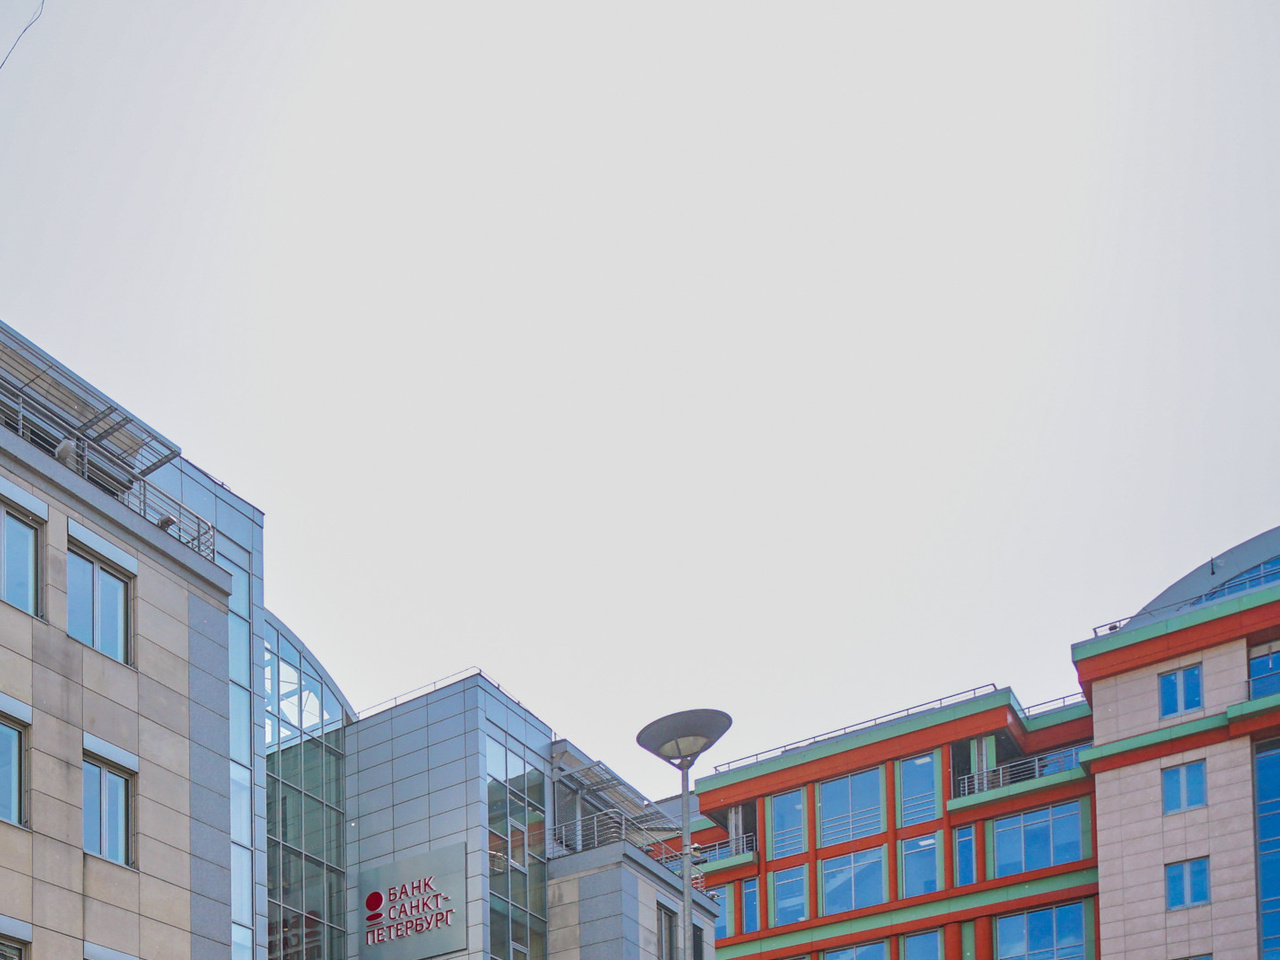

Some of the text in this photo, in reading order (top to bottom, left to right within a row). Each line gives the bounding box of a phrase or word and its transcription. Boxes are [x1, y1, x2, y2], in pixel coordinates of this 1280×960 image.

[388, 876, 434, 902] БАНК
[388, 893, 449, 920] САНКТ-
[365, 909, 454, 945] ПЕТЕРБУРГ
